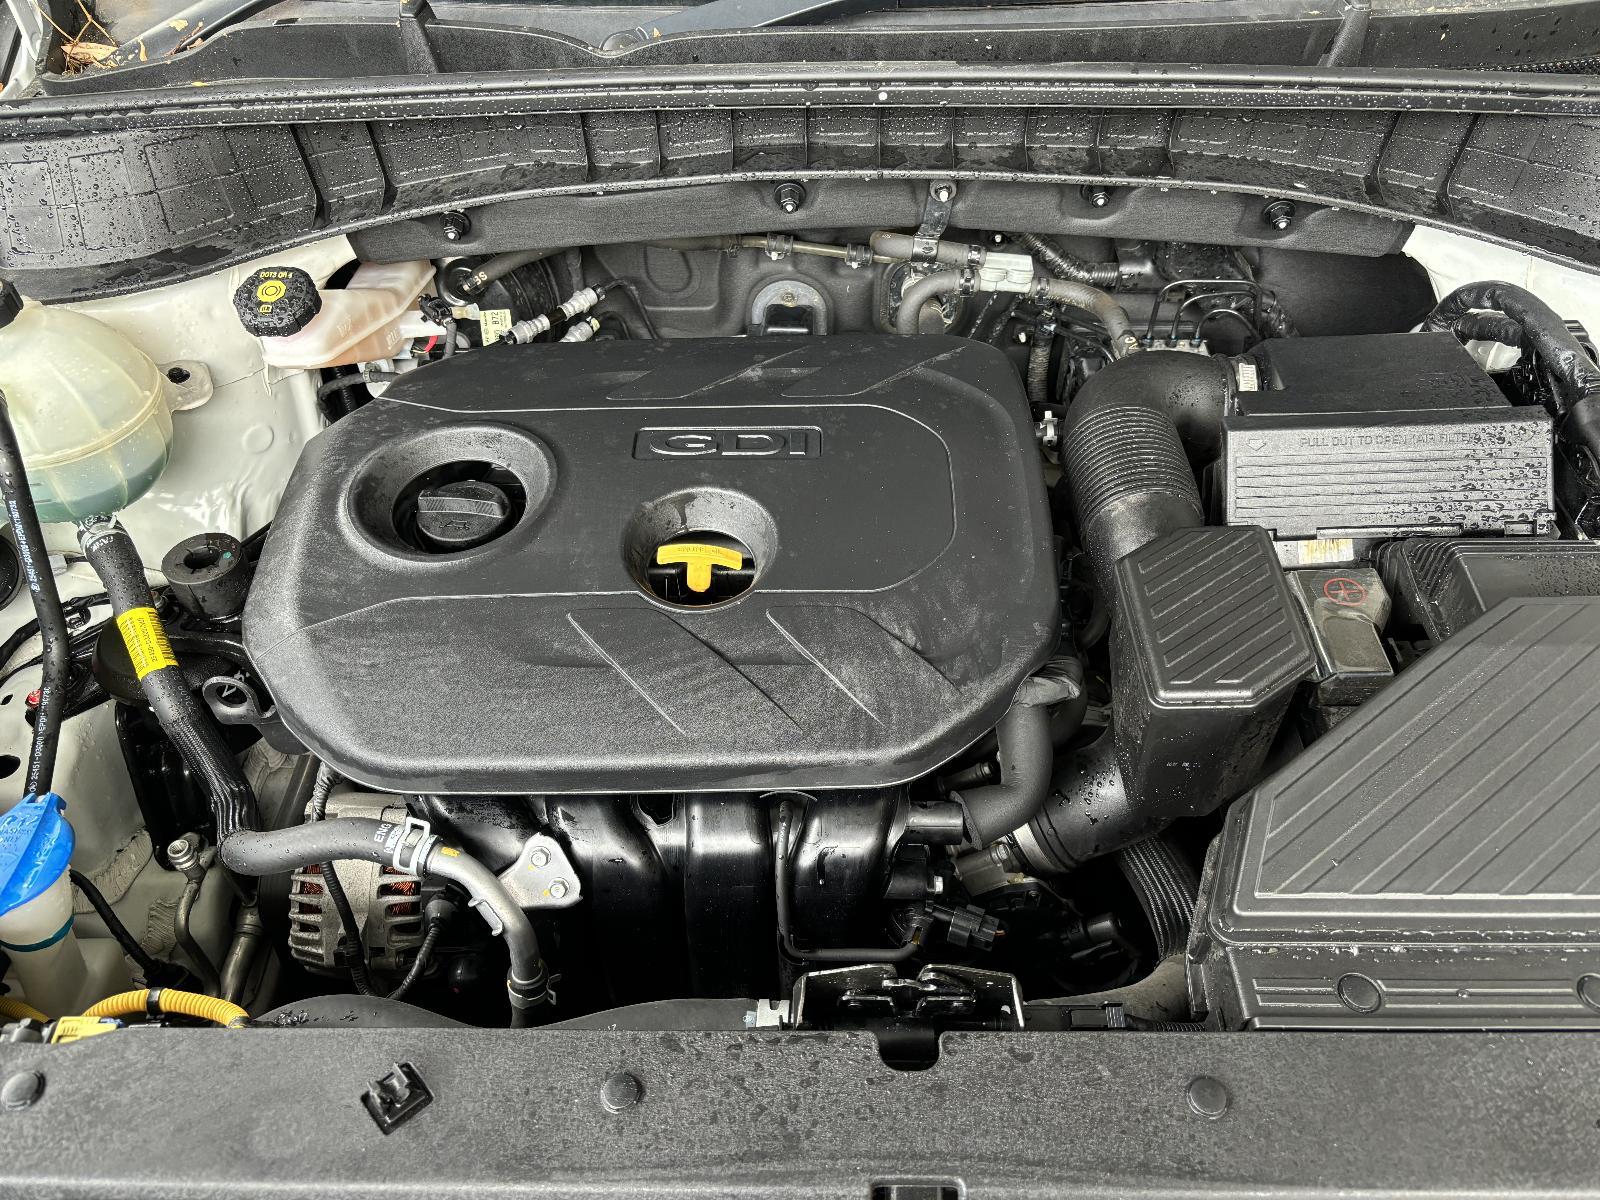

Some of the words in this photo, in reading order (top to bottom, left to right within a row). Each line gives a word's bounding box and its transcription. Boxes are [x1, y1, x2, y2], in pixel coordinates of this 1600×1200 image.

[650, 433, 806, 456] GDI
[1300, 437, 1329, 448] PULL
[1332, 435, 1355, 447] OUT
[1356, 434, 1373, 446] TO
[1375, 433, 1407, 446] OPEN
[373, 823, 393, 843] ENG
